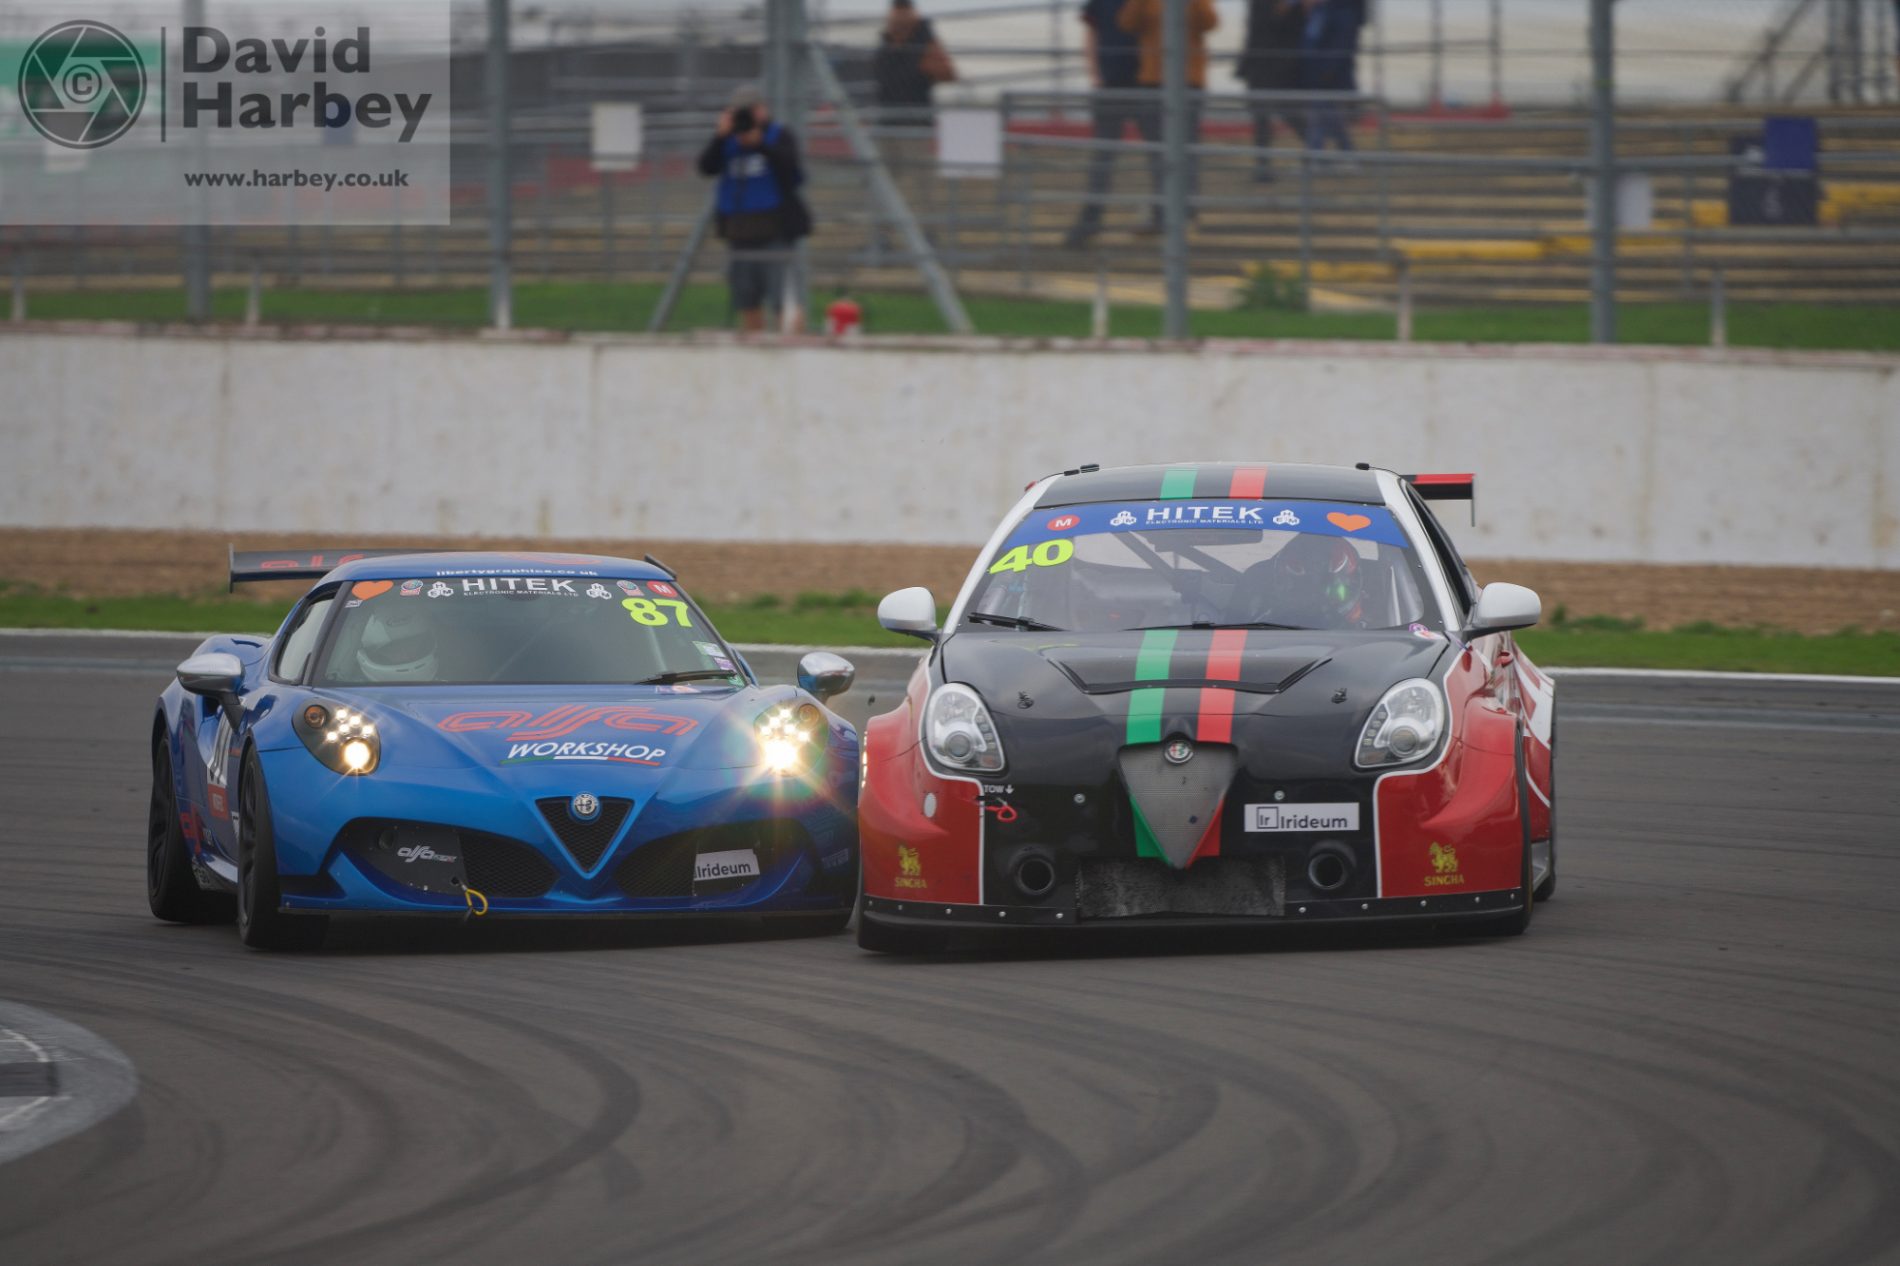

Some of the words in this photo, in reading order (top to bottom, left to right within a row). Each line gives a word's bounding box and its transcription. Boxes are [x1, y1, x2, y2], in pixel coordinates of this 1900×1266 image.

[1147, 506, 1264, 520] HITEK
[988, 538, 1074, 574] 40
[462, 578, 576, 592] HITEK
[621, 597, 693, 627] 87
[437, 703, 699, 741] alfa
[508, 742, 666, 761] WORKSHOP
[984, 785, 1005, 793] TOW
[1281, 815, 1348, 829] Irideum
[697, 862, 751, 878] Irideum
[1424, 874, 1464, 887] SINGHA
